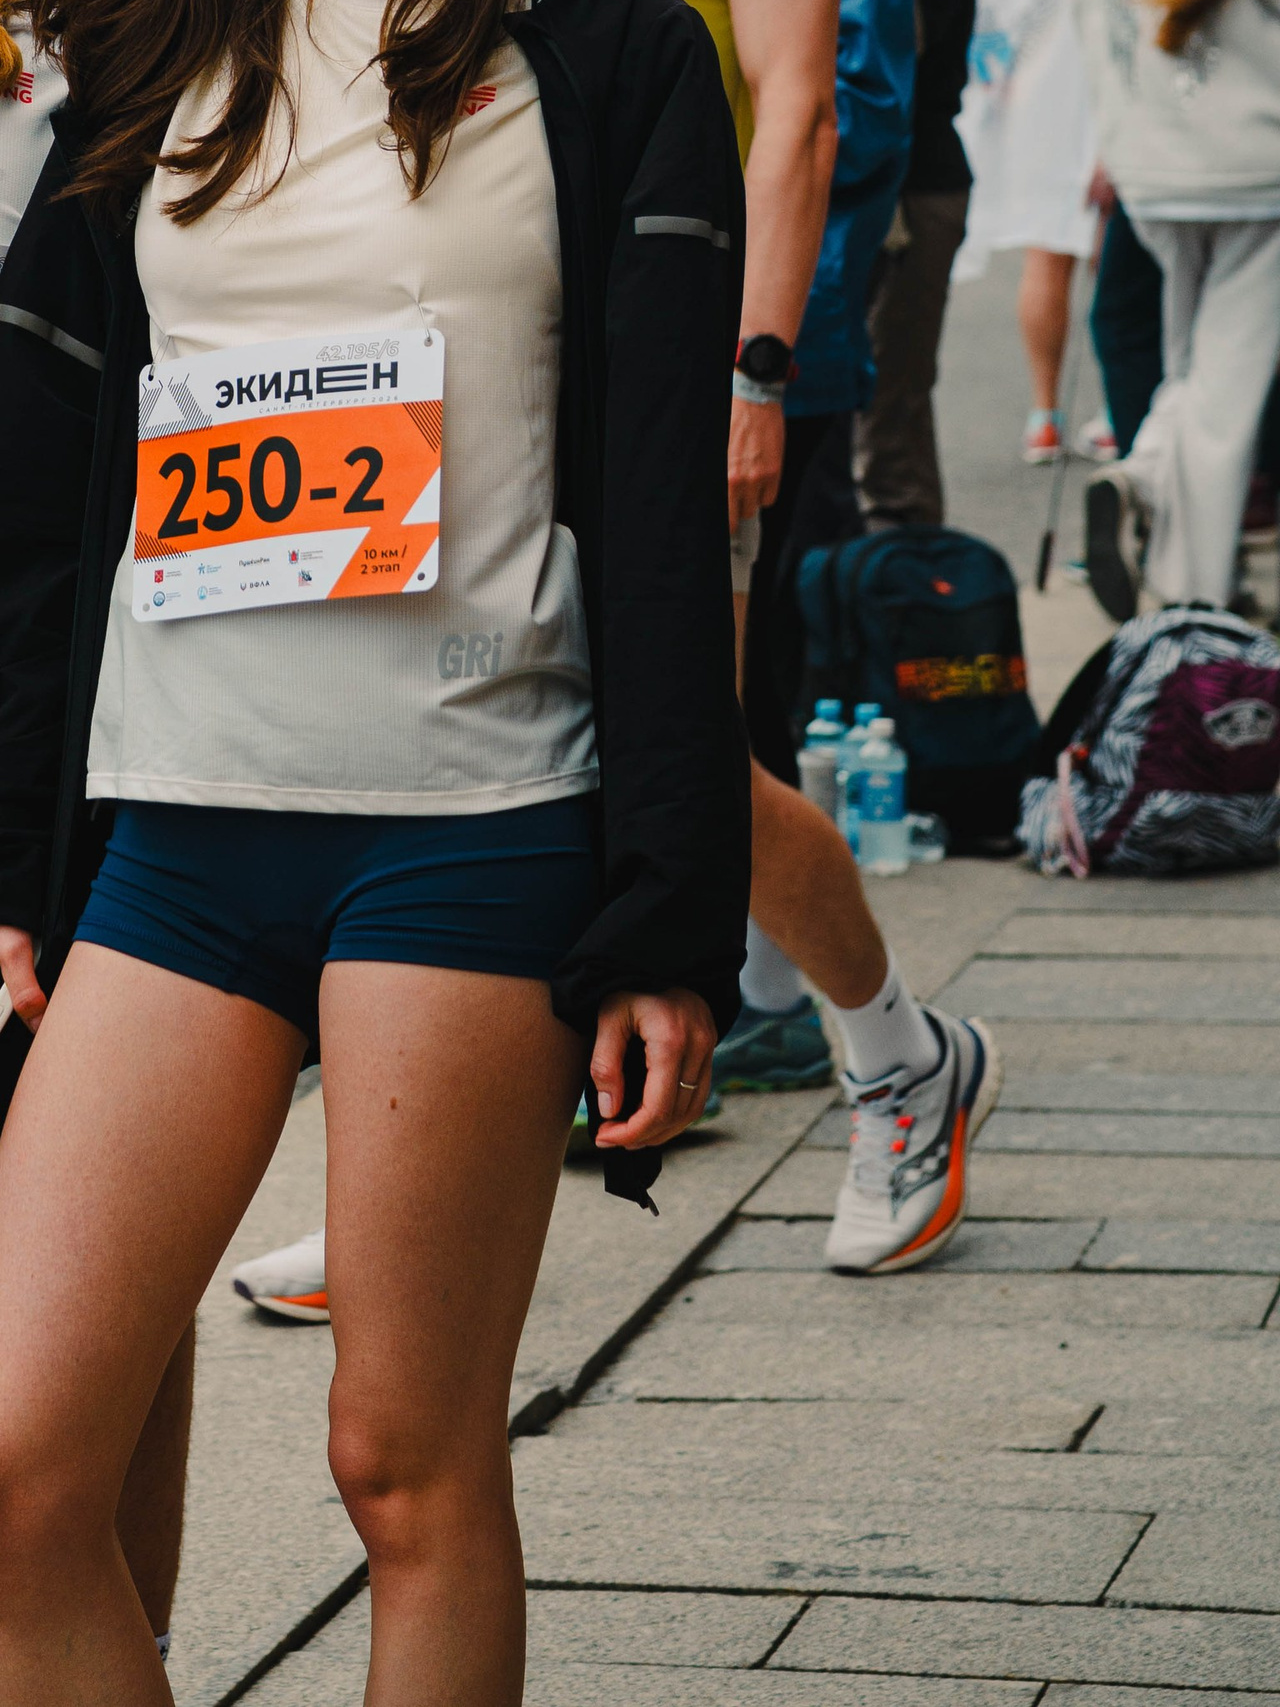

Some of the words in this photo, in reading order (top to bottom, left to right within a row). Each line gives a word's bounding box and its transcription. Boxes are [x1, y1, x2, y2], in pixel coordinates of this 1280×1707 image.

[316, 339, 400, 362] 42.195/6
[215, 361, 399, 409] ЭКИДЕН
[259, 397, 366, 414] САНКТ-ПЕТЕРБУРГ
[158, 435, 385, 540] 250-2
[363, 549, 377, 560] 10
[381, 550, 398, 559] км
[360, 564, 368, 575] 2
[371, 564, 400, 574] этап
